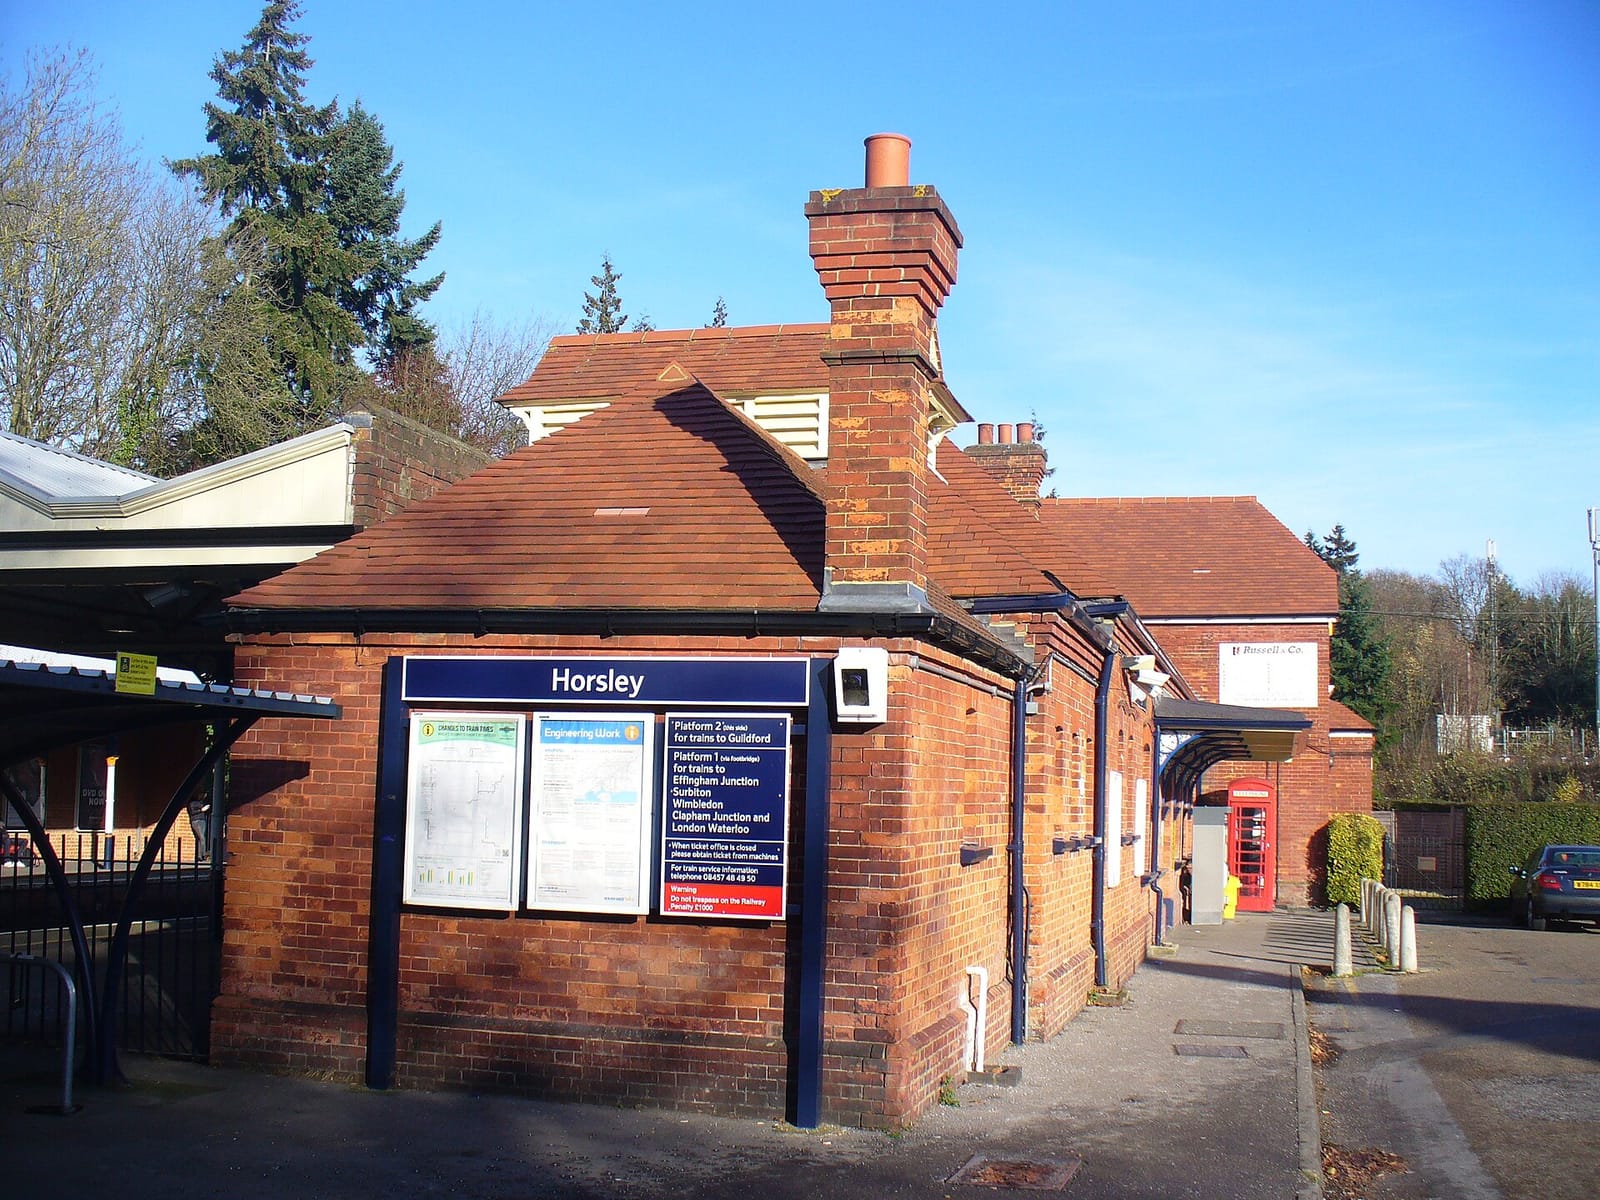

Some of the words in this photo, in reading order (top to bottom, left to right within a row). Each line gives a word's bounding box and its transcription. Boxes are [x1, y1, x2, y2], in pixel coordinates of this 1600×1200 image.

[1243, 645, 1280, 654] Russell
[551, 667, 645, 698] Horsley
[438, 724, 459, 732] CHANGES
[674, 721, 714, 731] Platform
[715, 721, 722, 731] 2
[544, 727, 594, 740] Engineering
[595, 728, 621, 738] Work
[674, 733, 688, 743] for
[689, 733, 715, 743] trains
[716, 734, 727, 743] to
[728, 733, 771, 744] Guildford
[673, 751, 712, 761] Platform
[713, 752, 719, 761] 1
[673, 763, 687, 773] for
[688, 764, 714, 774] trains
[715, 764, 726, 774] to
[673, 775, 719, 787] Effingham
[720, 776, 759, 786] Junction
[82, 788, 97, 797] DVD
[673, 787, 712, 797] Surbiton
[672, 798, 724, 809] Wimbledon
[672, 810, 711, 822] Clapham
[712, 811, 751, 822] Junction
[753, 813, 770, 823] and
[672, 822, 706, 833] London
[708, 822, 750, 834] Waterloo
[671, 841, 690, 850] When
[691, 842, 709, 850] ticket
[710, 843, 729, 851] office
[730, 843, 735, 851] is
[736, 844, 757, 852] closed
[671, 850, 691, 858] please
[732, 852, 748, 860] from
[749, 853, 779, 861] machines
[671, 864, 682, 872] For
[683, 864, 697, 872] train
[698, 865, 721, 873] service
[722, 866, 759, 874] information
[671, 872, 702, 881] telephone
[703, 873, 725, 881] 08457
[726, 874, 736, 882] 48
[736, 874, 746, 882] 49
[670, 885, 697, 894] Warning
[692, 896, 719, 905] trespass
[741, 898, 766, 907] Railway
[670, 903, 694, 912] Penalty
